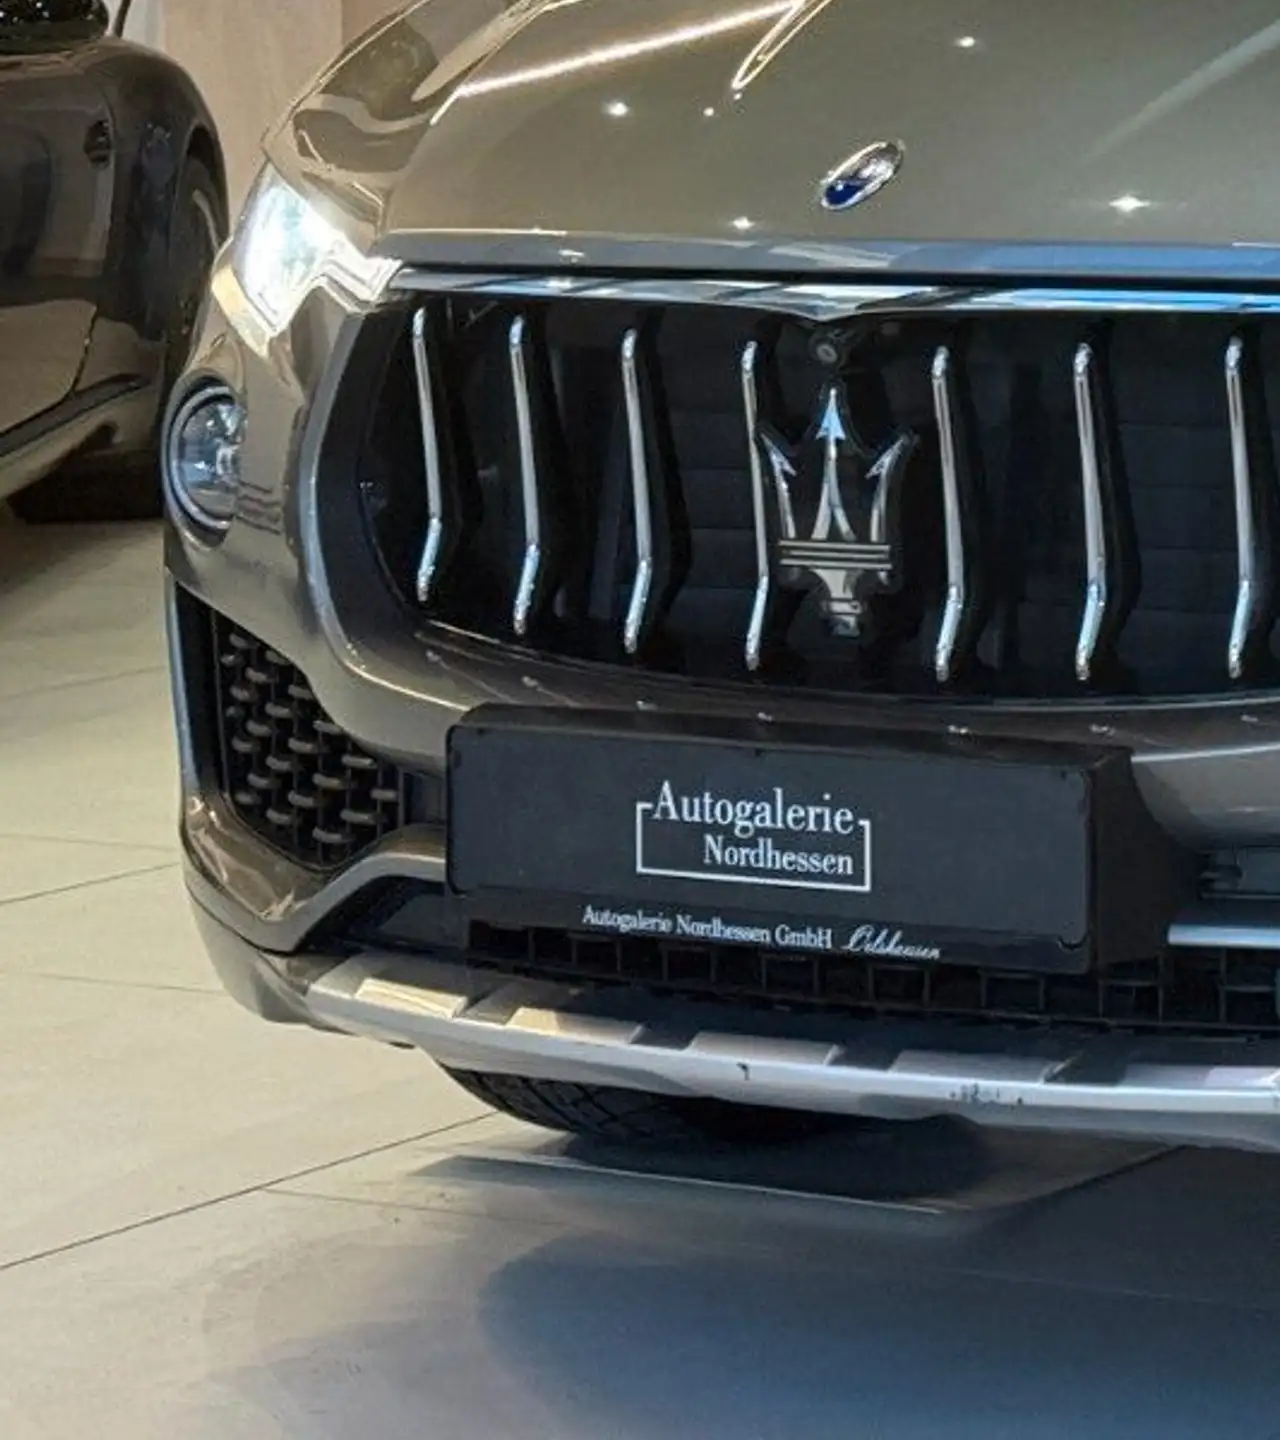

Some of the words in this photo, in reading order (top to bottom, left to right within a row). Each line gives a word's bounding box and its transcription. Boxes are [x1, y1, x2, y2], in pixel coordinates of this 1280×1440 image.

[653, 780, 855, 838] Autogalerie
[703, 834, 854, 875] Nordhessen
[582, 905, 672, 933] Autogalerie
[676, 914, 770, 944] Nordhessen
[775, 924, 833, 950] GmbH
